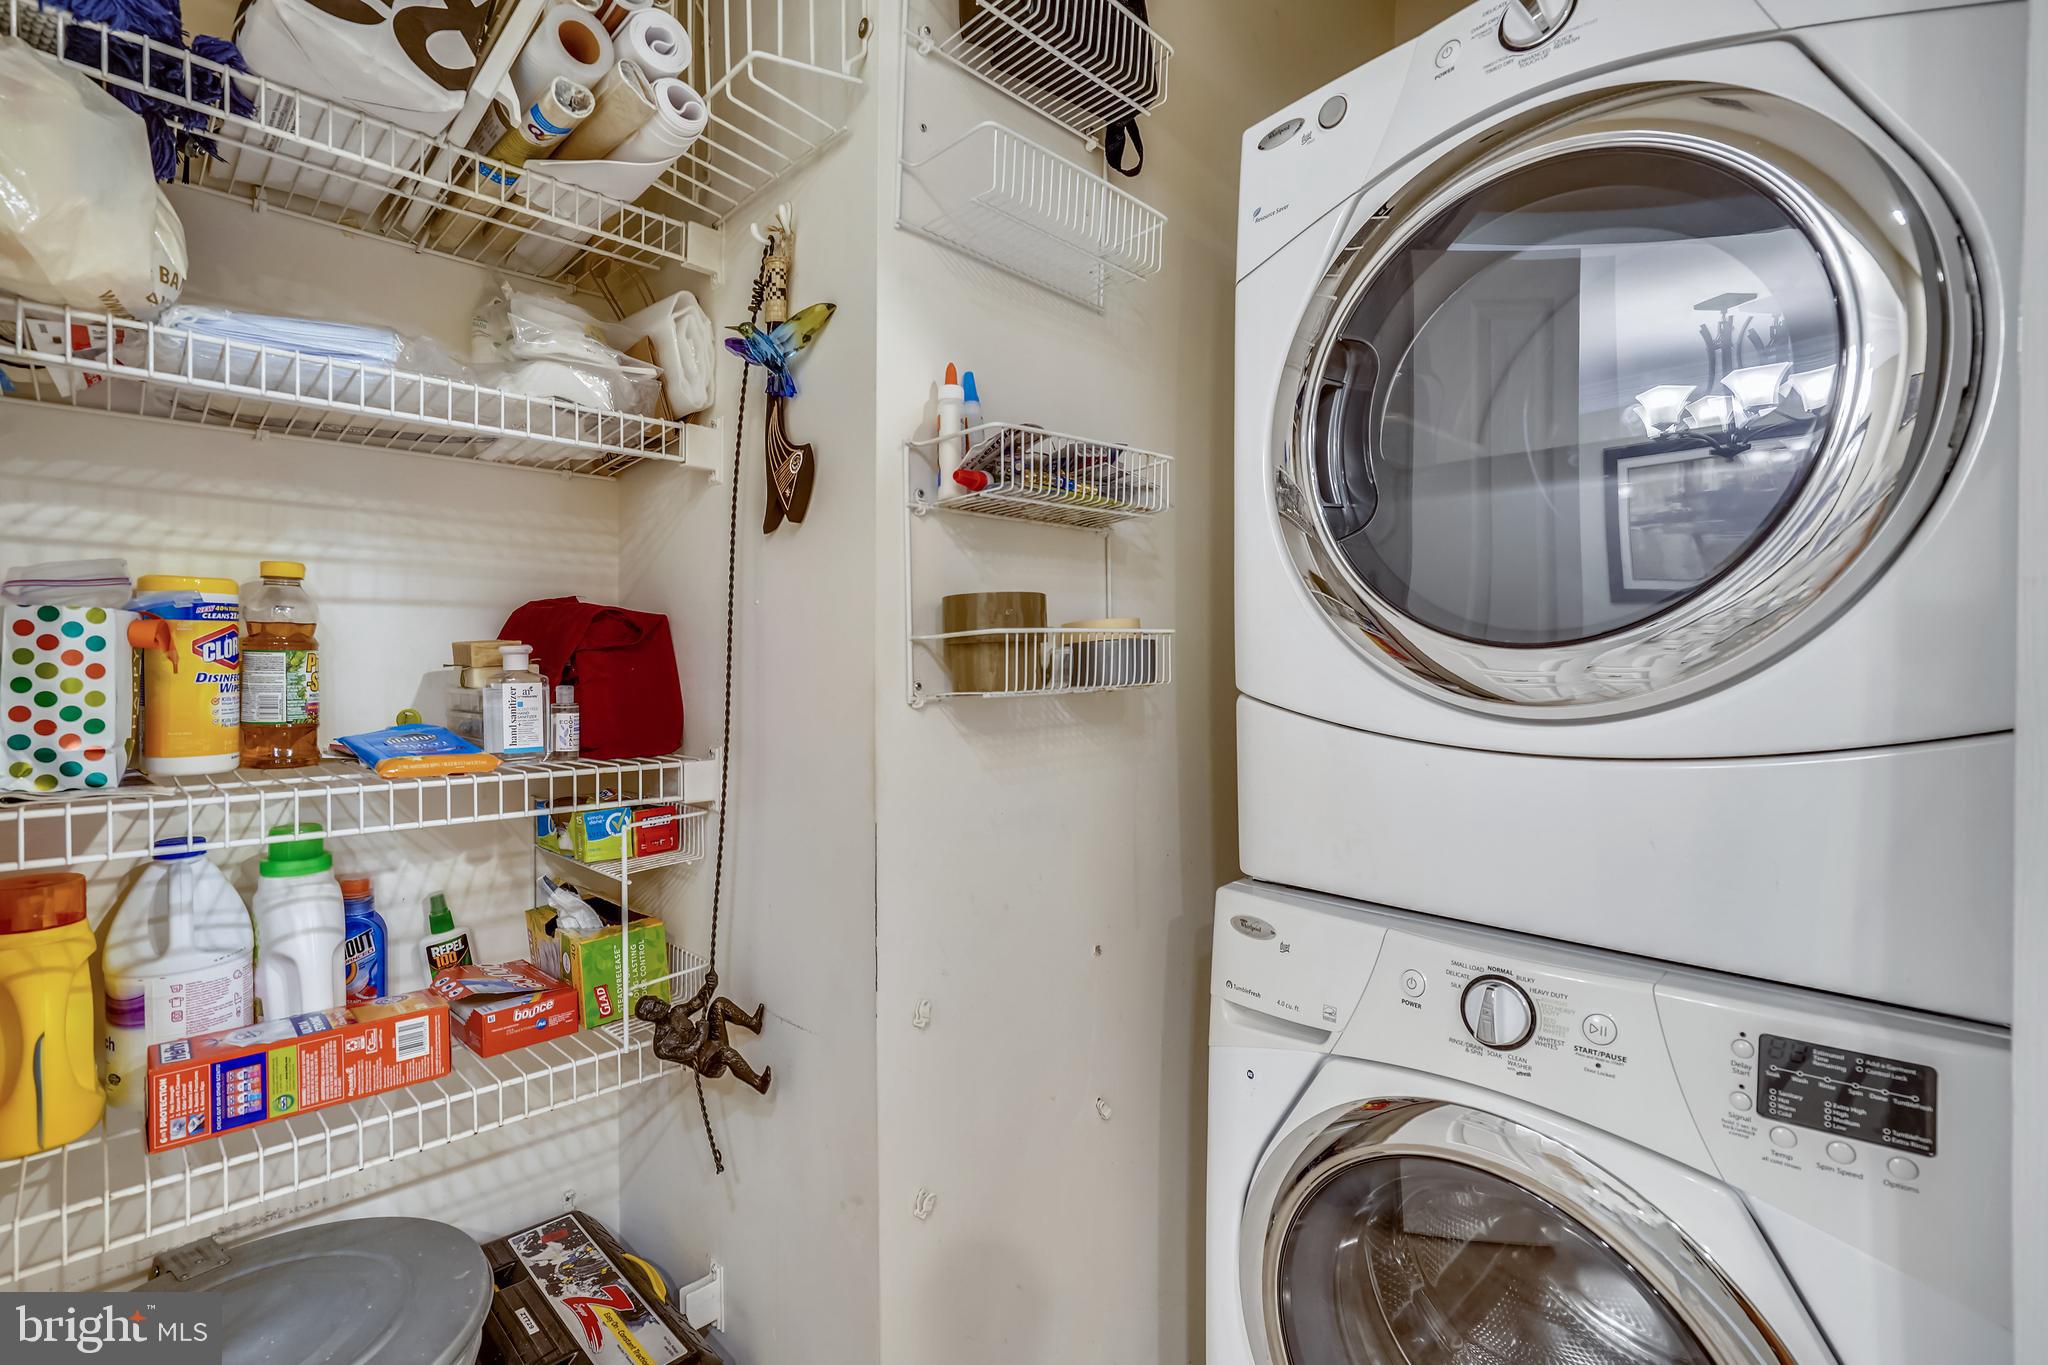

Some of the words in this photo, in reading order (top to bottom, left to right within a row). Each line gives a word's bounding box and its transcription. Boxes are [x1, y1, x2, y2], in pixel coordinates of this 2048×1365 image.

[1434, 66, 1455, 80] POWER
[1254, 210, 1276, 223] Resource
[1276, 204, 1289, 214] Saver
[508, 687, 517, 724] sanitizer
[509, 724, 518, 747] hand
[345, 930, 372, 959] OUT
[431, 938, 465, 958] REPEL
[434, 951, 458, 968] 100
[1450, 960, 1468, 970] SMALL
[1469, 964, 1484, 973] LOAD
[1487, 965, 1514, 976] NORMAL
[1445, 969, 1470, 980] DELICATE
[1515, 975, 1536, 983] BULKY
[1450, 981, 1462, 989] SILK
[1233, 984, 1262, 999] TumbleFresh
[1529, 987, 1549, 997] HEAVY
[1550, 991, 1568, 1000] DUTY
[596, 987, 611, 1015] GLAD
[1401, 998, 1422, 1009] POWER
[513, 999, 554, 1021] bounce
[1448, 1037, 1484, 1051] RINSE/DRAIN
[1534, 1040, 1558, 1051] WHITES
[1537, 1035, 1565, 1046] WHITEST
[1470, 1049, 1484, 1057] SPIN
[1487, 1050, 1502, 1059] SOAK
[1574, 1045, 1627, 1063] START/PAUSE
[1507, 1055, 1527, 1064] CLEAN
[1507, 1060, 1532, 1071] WASHER
[1730, 1059, 1752, 1071] Delay
[1732, 1067, 1750, 1077] Start
[1812, 1060, 1847, 1073] Remaining
[1777, 1110, 1792, 1118] Cold
[1832, 1102, 1850, 1112] Extra
[1851, 1105, 1867, 1116] High
[1832, 1109, 1849, 1118] High
[1728, 1112, 1752, 1123] Signal
[1832, 1116, 1860, 1128] Medium
[1832, 1123, 1847, 1131] Low
[1771, 1149, 1793, 1161] Temp
[1816, 1161, 1835, 1174] Spin
[1837, 1167, 1864, 1180] Speed
[1883, 1178, 1920, 1194] Options
[603, 1311, 613, 1323] Easy
[611, 1321, 618, 1329] On
[618, 1330, 636, 1350] Constant
